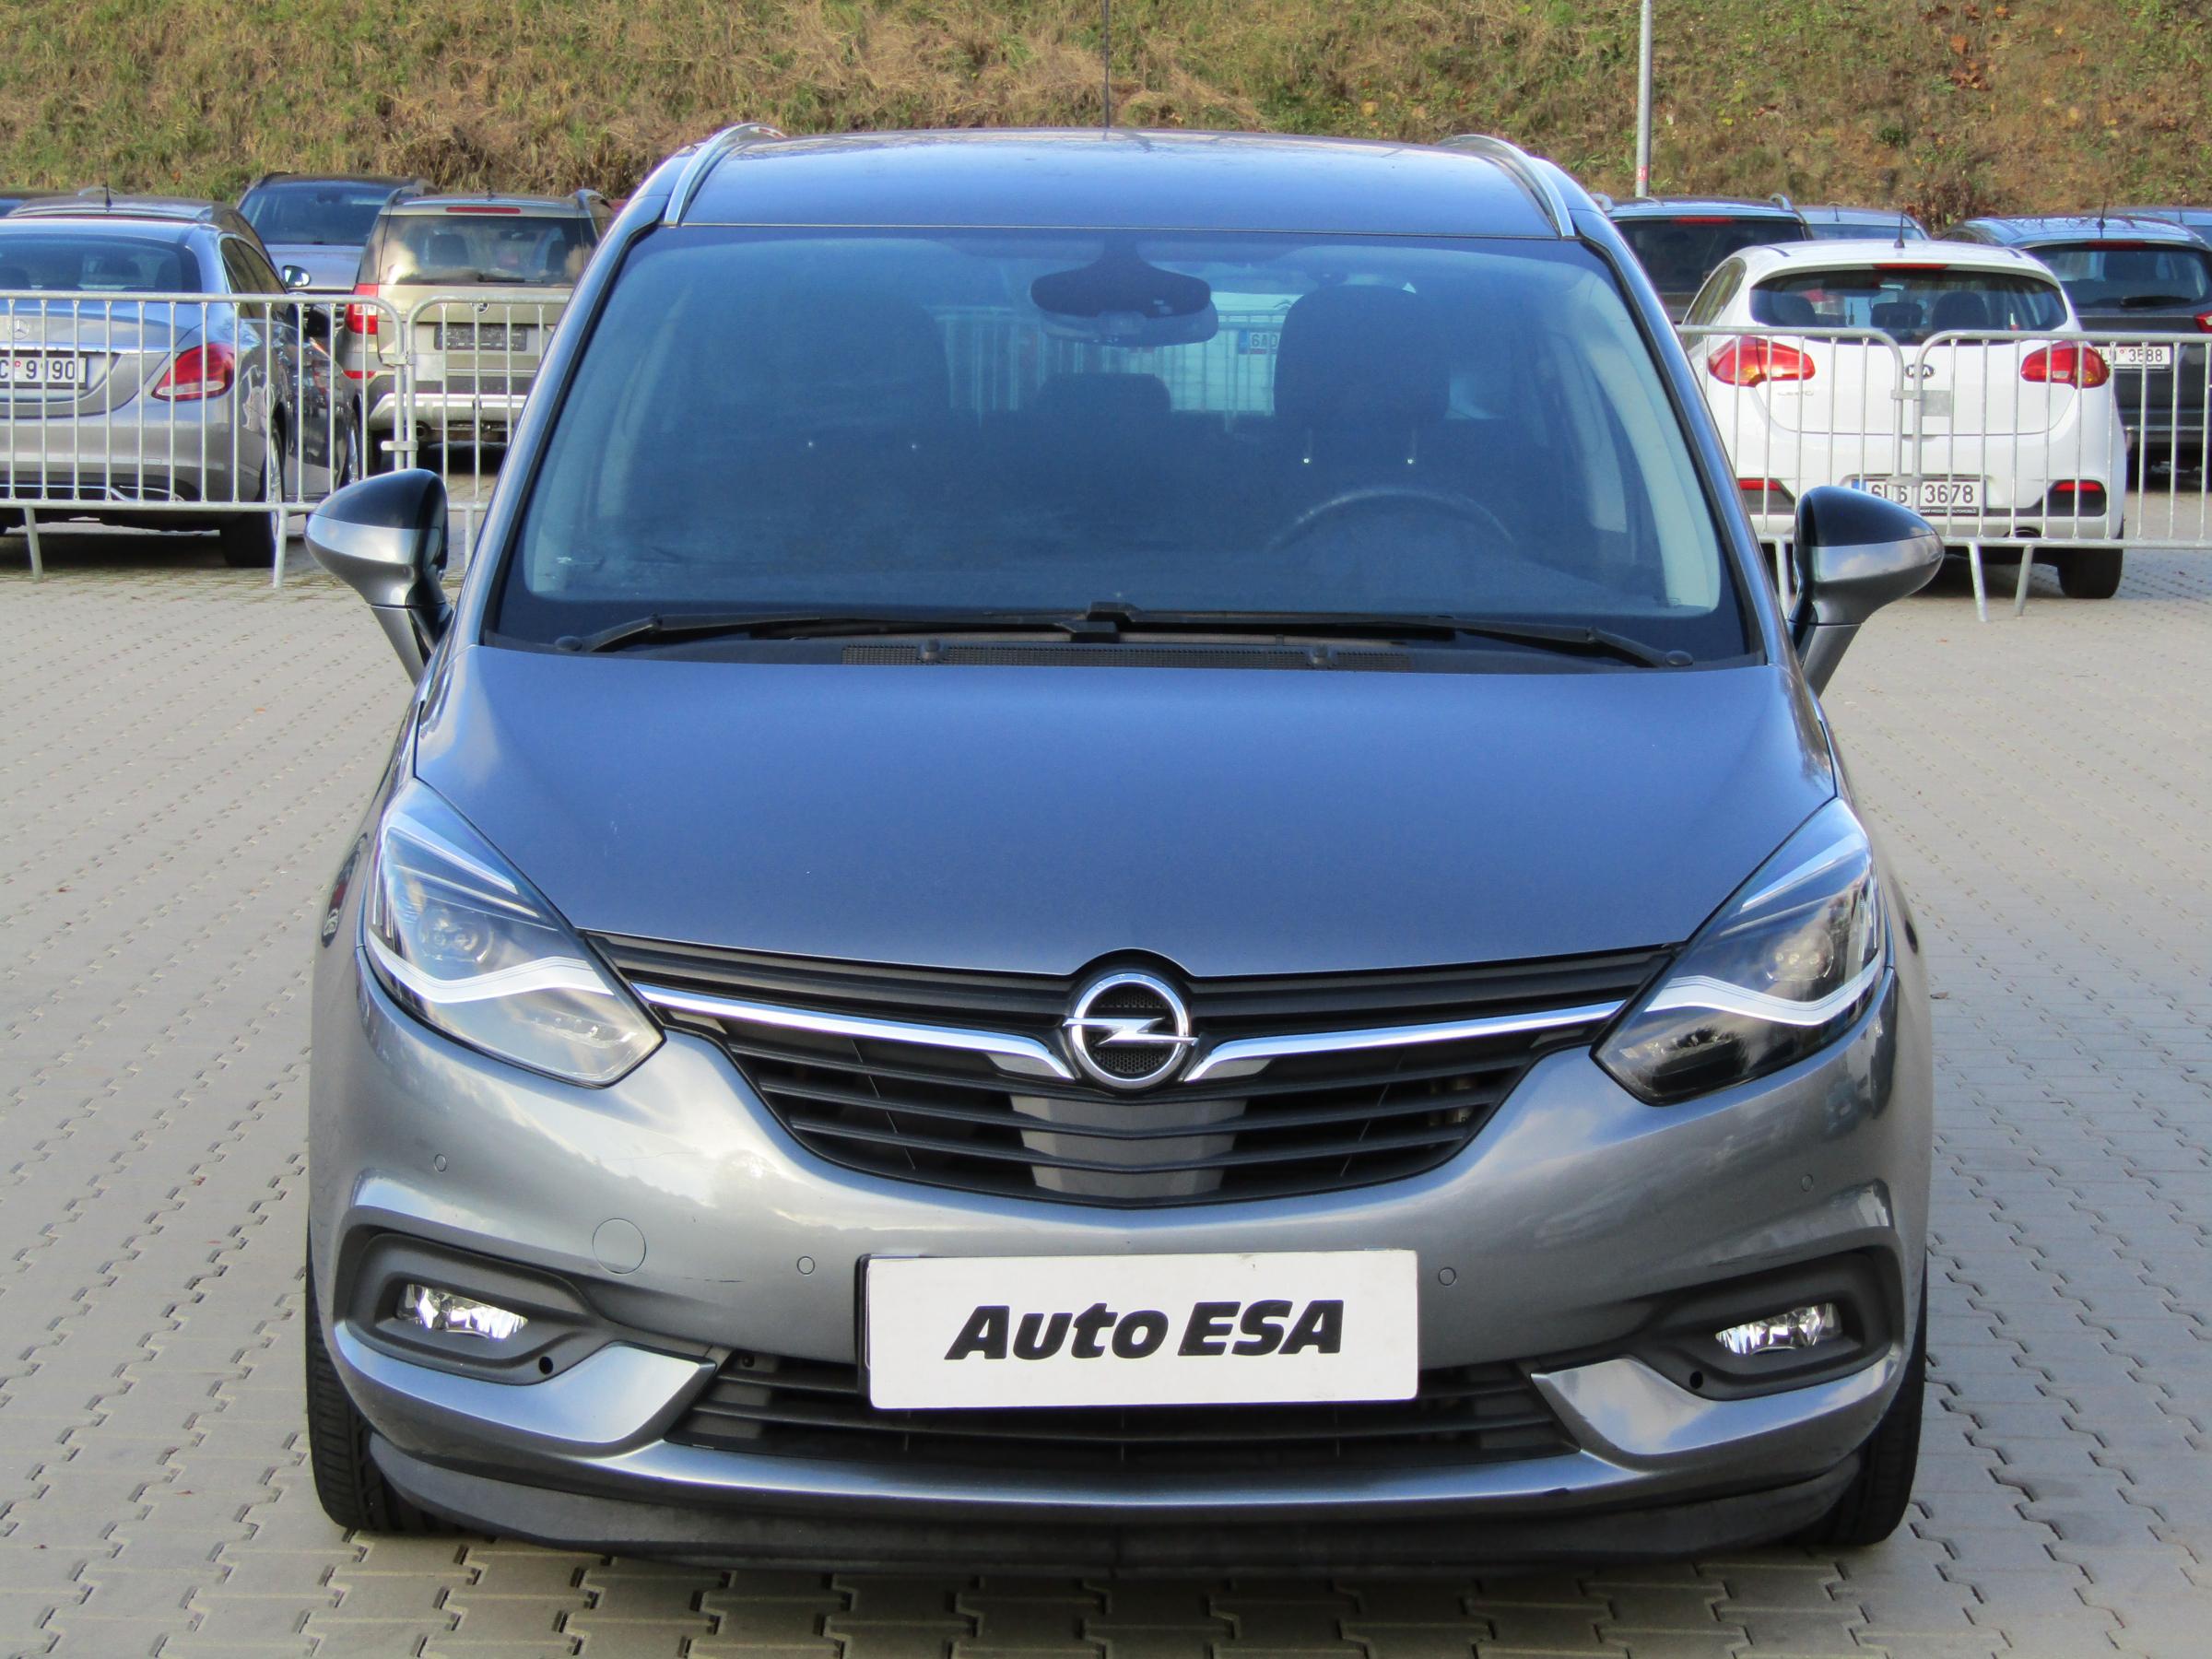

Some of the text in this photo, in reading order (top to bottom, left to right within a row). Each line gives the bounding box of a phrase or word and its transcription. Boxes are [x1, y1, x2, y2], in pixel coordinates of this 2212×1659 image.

[2128, 348, 2162, 362] 3588
[1924, 484, 1973, 503] 3678
[944, 1300, 1344, 1360] Auto ESA
